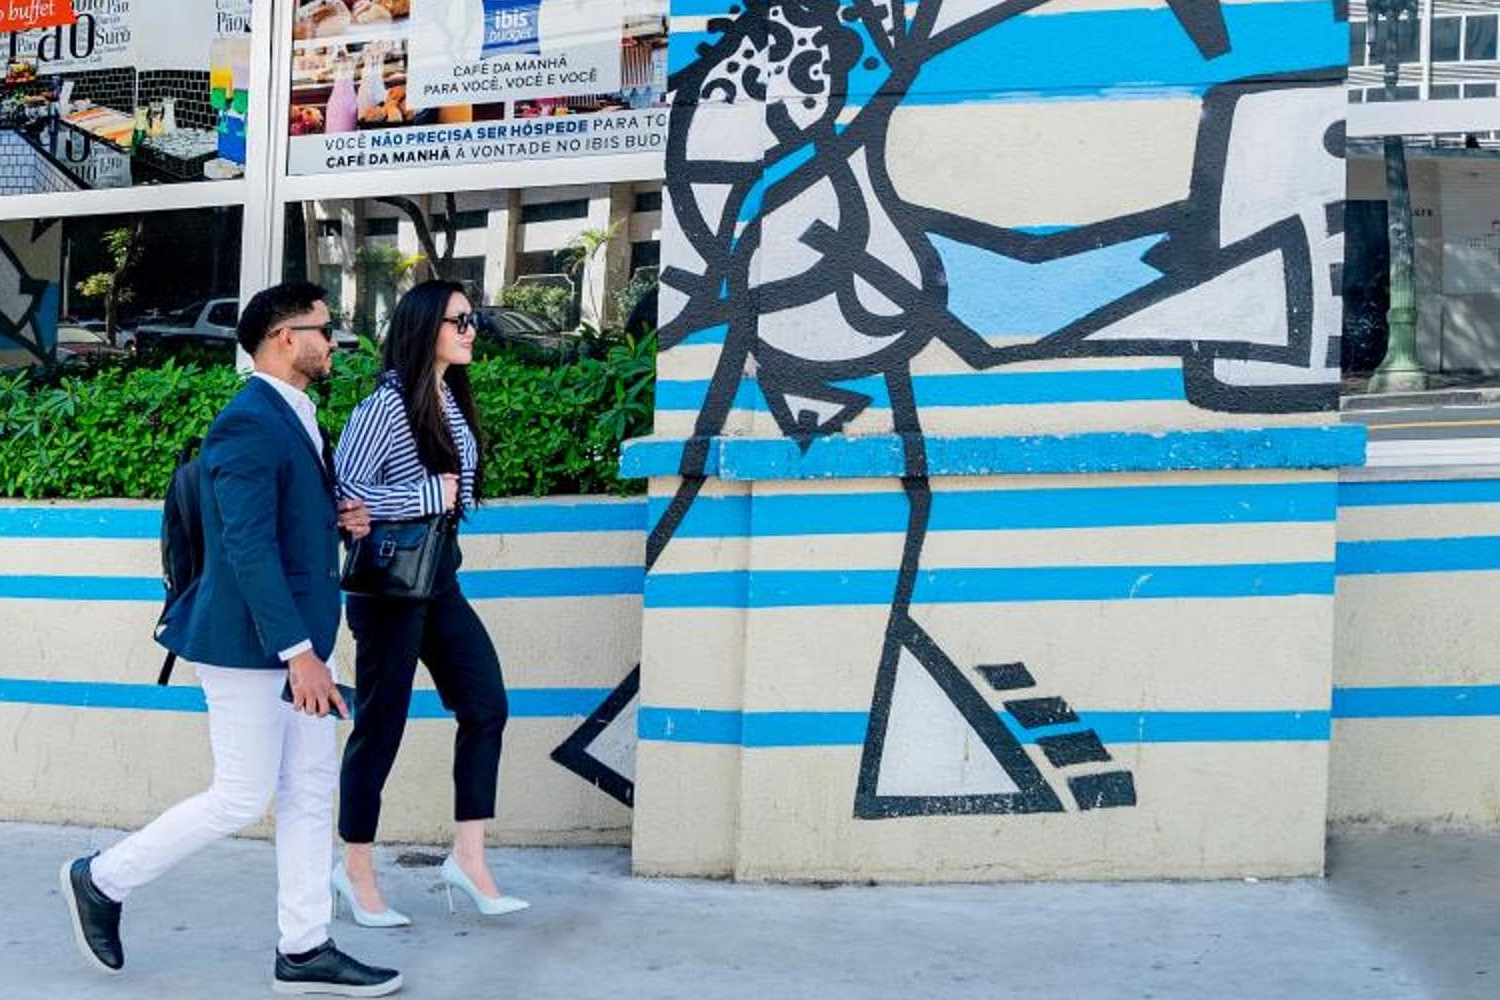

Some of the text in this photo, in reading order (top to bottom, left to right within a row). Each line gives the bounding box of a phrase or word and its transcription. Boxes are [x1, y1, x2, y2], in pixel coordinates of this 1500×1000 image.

[495, 8, 529, 29] ibis
[453, 54, 567, 77] CAFÉ DA MANHÃ
[424, 83, 458, 96] PARA
[505, 73, 543, 88] VOCÊ
[547, 73, 555, 85] E
[559, 67, 597, 84] VOCÊ
[325, 134, 366, 150] VOCÊ
[371, 132, 403, 147] NÃO
[405, 127, 473, 145] PRECISA
[477, 124, 507, 138] SER
[511, 119, 589, 137] HÓSPEDE
[593, 115, 639, 131] PARA
[326, 152, 366, 169] CAFÉ
[369, 152, 389, 165] DA
[392, 146, 450, 163] MANHÃ
[471, 141, 550, 159] VONTADE
[556, 138, 581, 152] NO
[585, 135, 619, 150] IBIS
[625, 133, 667, 148] BUD
